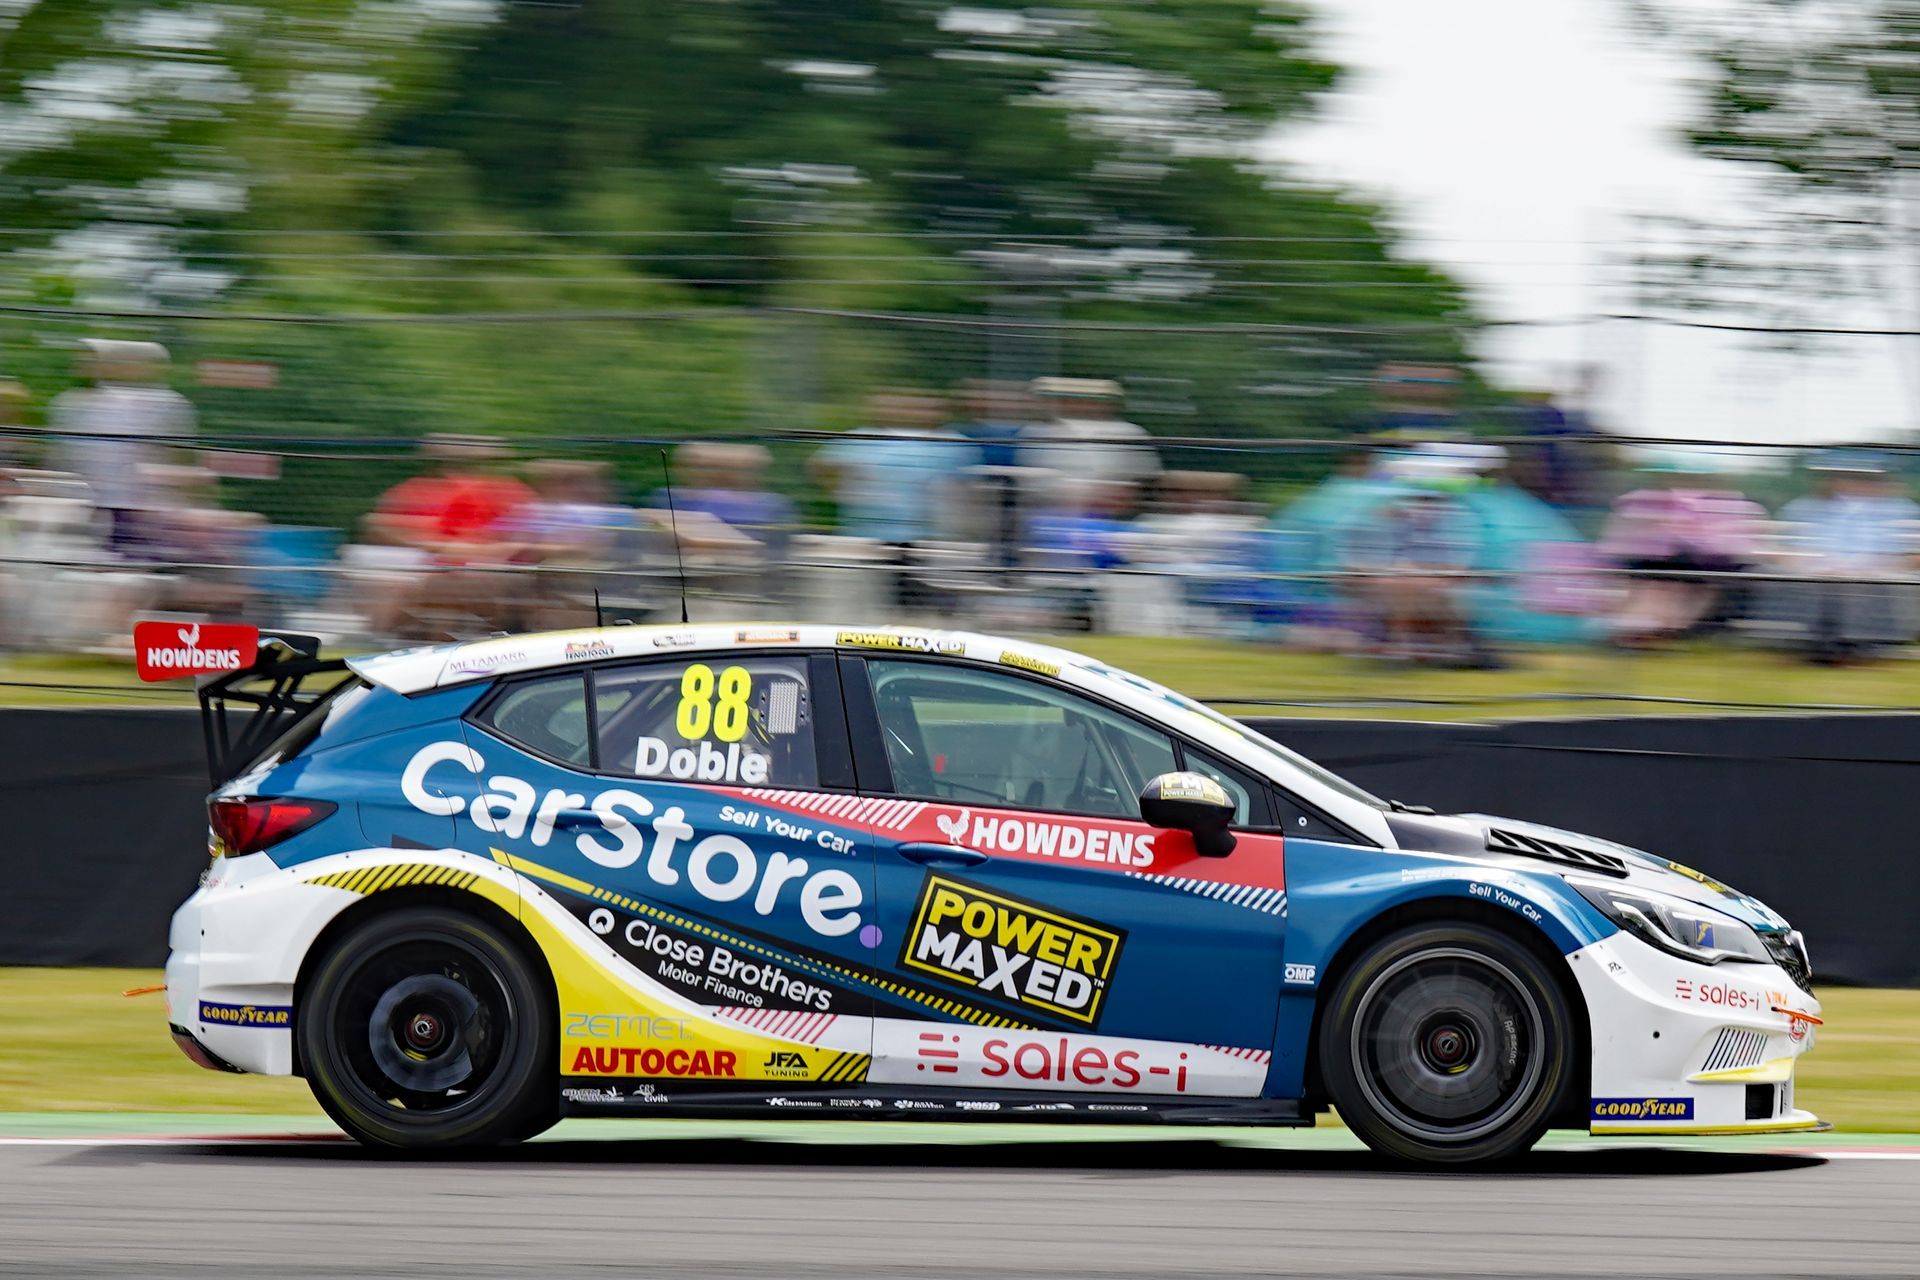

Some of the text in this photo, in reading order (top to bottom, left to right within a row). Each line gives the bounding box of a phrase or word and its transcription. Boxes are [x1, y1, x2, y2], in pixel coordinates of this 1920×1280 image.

[842, 631, 962, 653] POWER MAXED
[147, 648, 241, 669] HOWDENS
[676, 664, 751, 742] 88
[635, 736, 768, 784] Doble
[719, 805, 759, 828] Sell
[765, 815, 812, 842] Your
[971, 816, 1155, 867] HOWDENS
[1469, 882, 1491, 898] Sell
[1494, 889, 1521, 909] Your
[928, 888, 1102, 976] POWER
[625, 919, 833, 1010] Close Brothers
[916, 924, 1092, 1009] MAXED
[1284, 967, 1316, 981] OMP
[657, 960, 763, 1008] Motor Finance
[1699, 983, 1760, 1011] sales-i
[202, 1005, 289, 1024] GOODYEAR
[565, 1013, 692, 1040] ZETMET
[572, 1047, 737, 1077] AUTOCAR
[763, 1052, 808, 1069] JFA
[764, 1070, 809, 1078] TUNING
[980, 1037, 1187, 1092] sales-i
[1595, 1099, 1686, 1118] GOODYEAR
